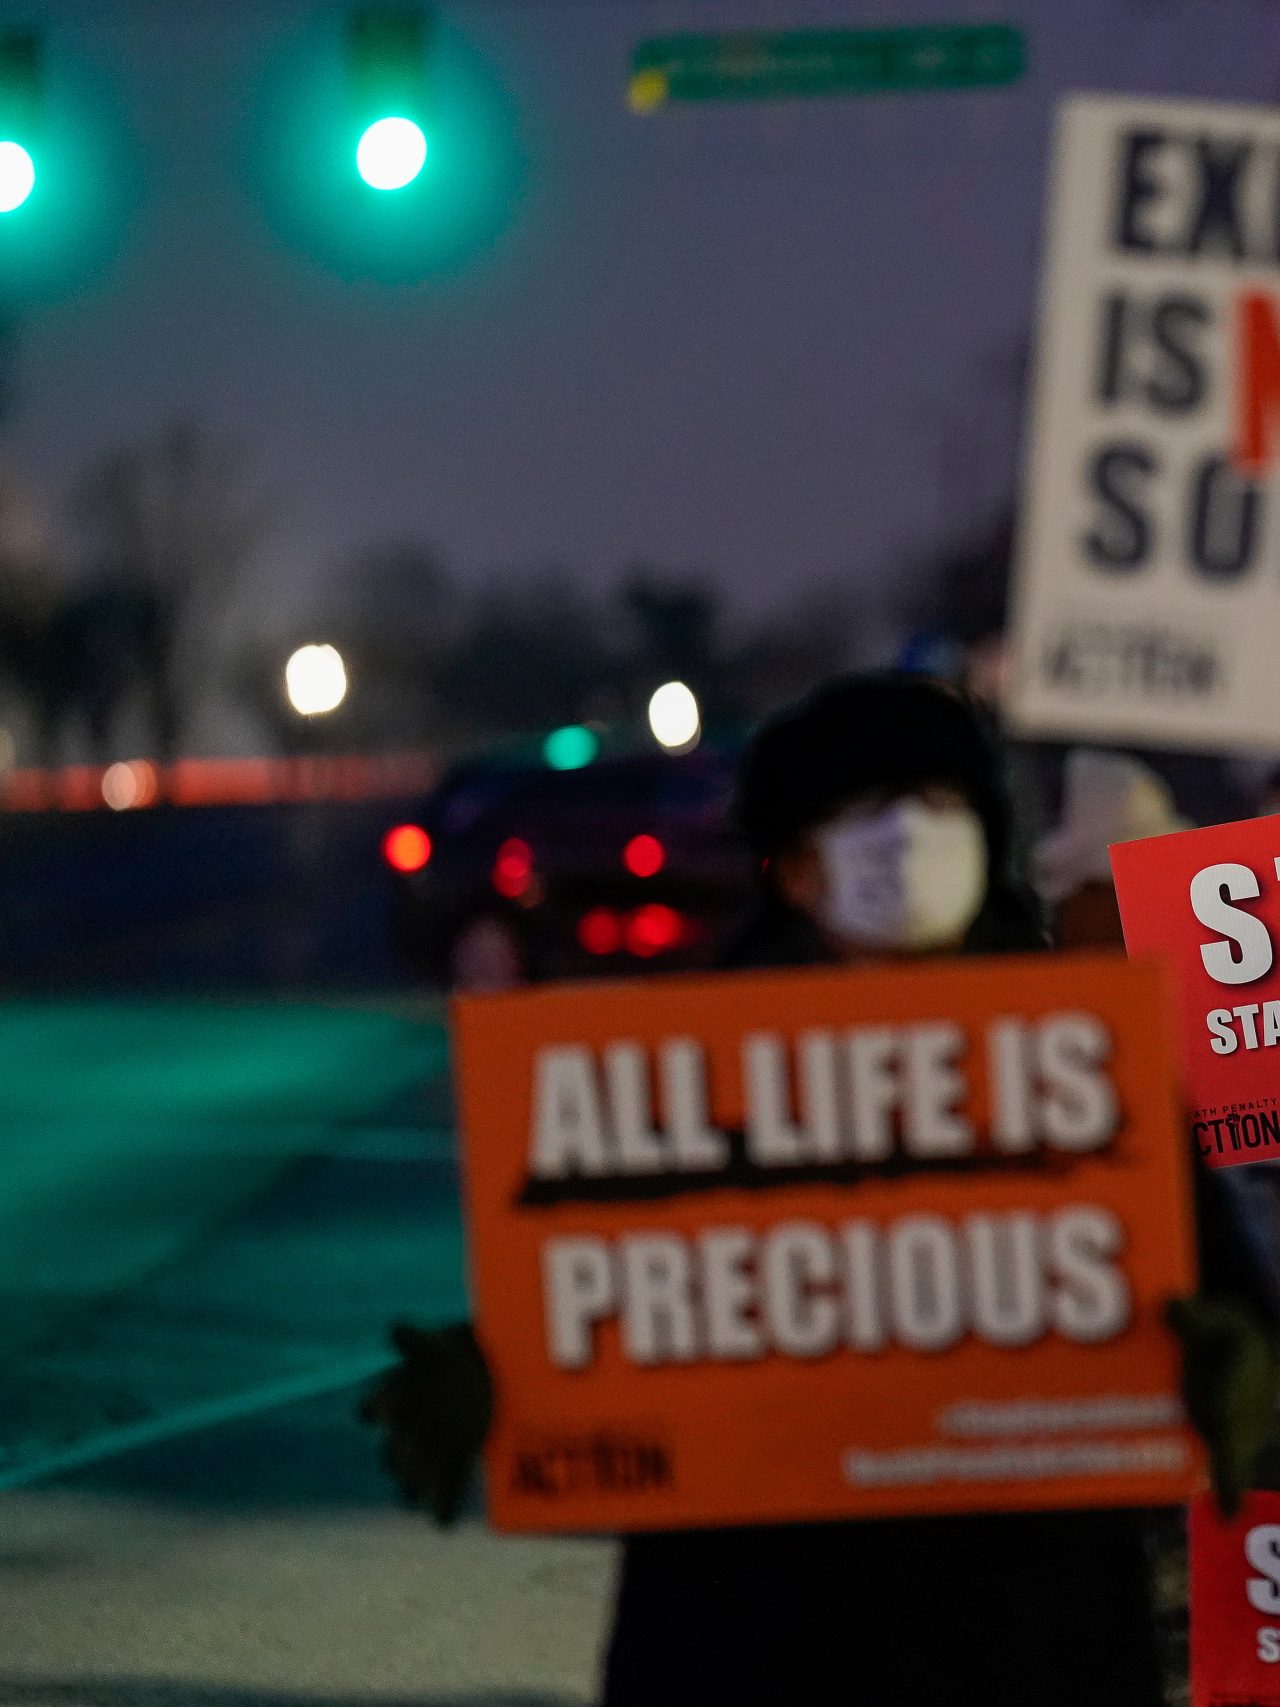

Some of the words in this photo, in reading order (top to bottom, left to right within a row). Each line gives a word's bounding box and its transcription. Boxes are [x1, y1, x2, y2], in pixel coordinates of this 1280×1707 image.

[1095, 289, 1212, 413] IS
[527, 1042, 730, 1181] ALL
[742, 1020, 975, 1167] LIFE
[986, 1011, 1123, 1155] IS
[1194, 1107, 1217, 1118] ATH
[1222, 1098, 1277, 1113] PENALTY
[541, 1207, 1129, 1369] PRECIOUS
